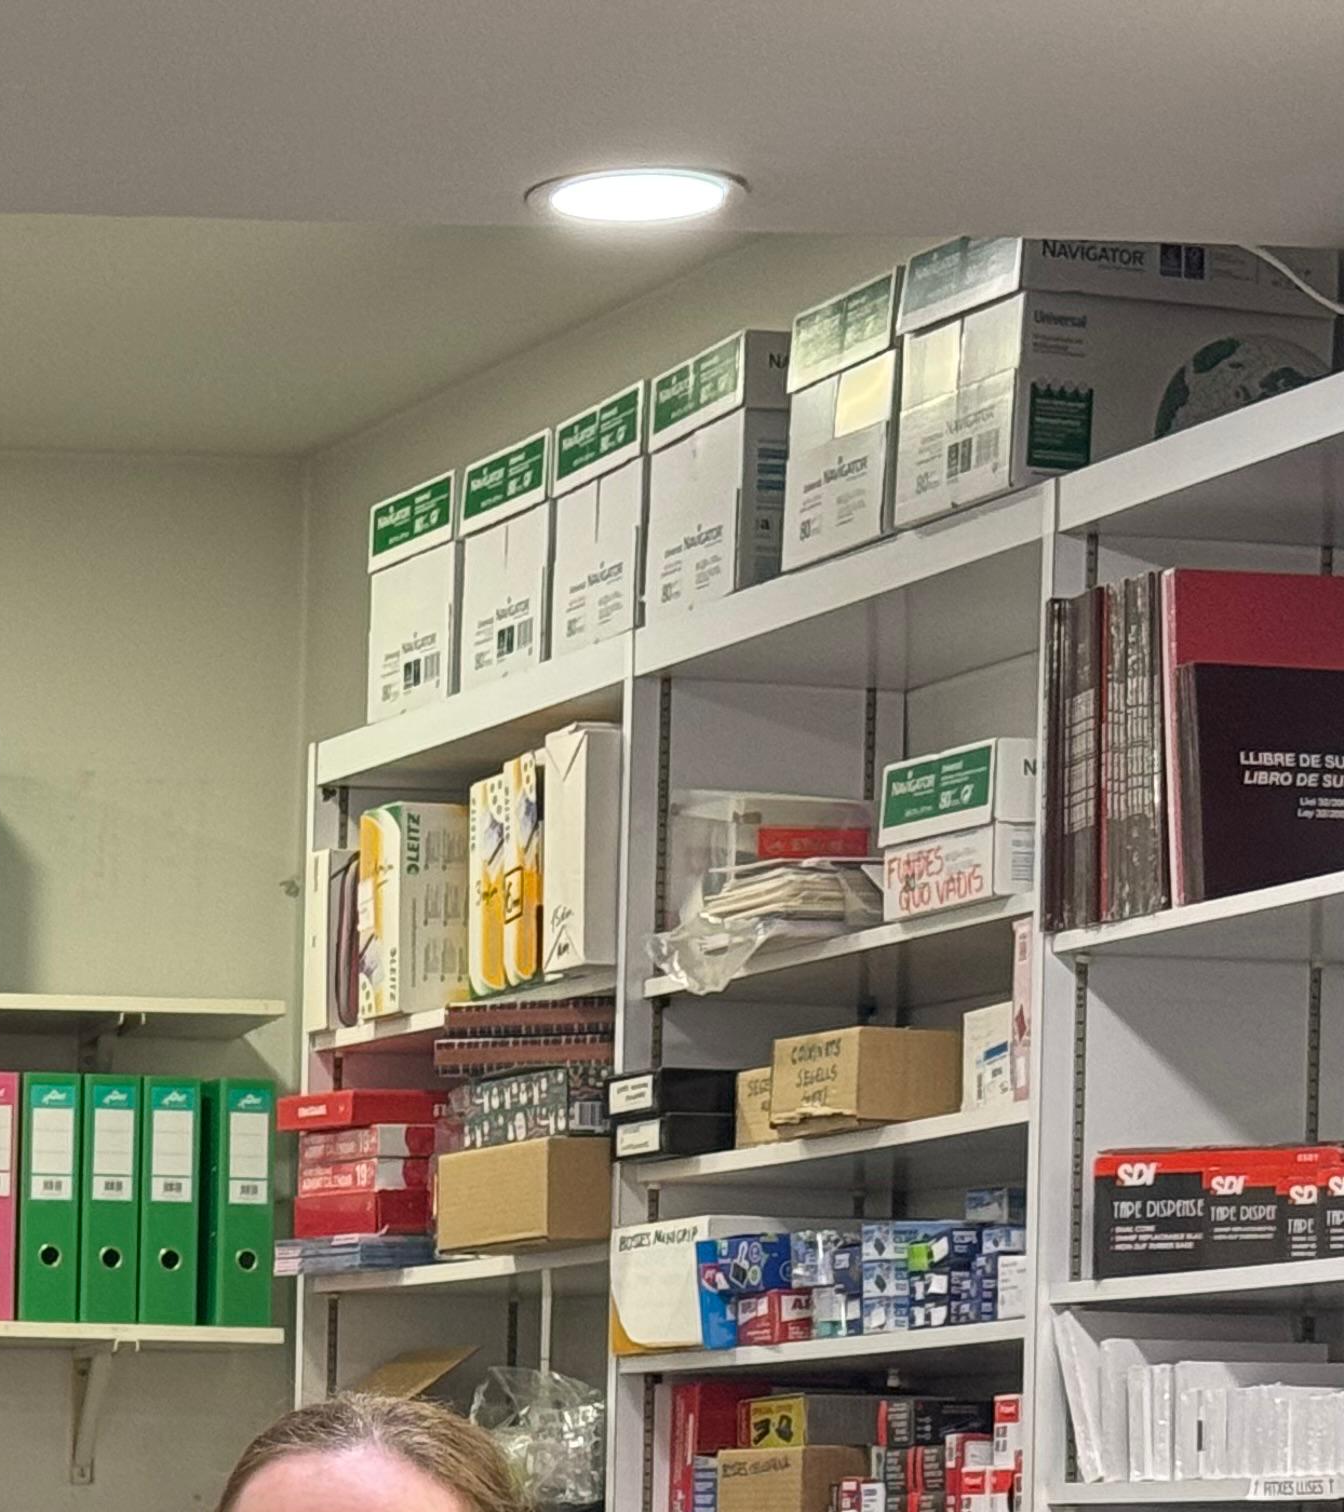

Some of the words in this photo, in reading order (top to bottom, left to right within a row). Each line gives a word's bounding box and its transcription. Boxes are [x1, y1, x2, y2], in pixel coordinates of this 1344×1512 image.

[1042, 239, 1146, 266] NAVIGATOR
[1033, 310, 1087, 328] Universal
[1240, 751, 1296, 767] LLIBRE
[1299, 754, 1322, 768] DE
[1325, 755, 1344, 769] SU
[891, 771, 935, 796] NAVIGATOR
[1244, 770, 1292, 786] LIBRO
[1296, 773, 1319, 787] DE
[1322, 774, 1344, 788] SU
[407, 813, 420, 861] LEITZ
[1117, 1163, 1157, 1186] SDI
[1211, 1176, 1246, 1195] SDI
[1113, 1201, 1141, 1219] TAPE
[1211, 1207, 1237, 1222] TAPE
[1288, 1219, 1315, 1235] TAPE
